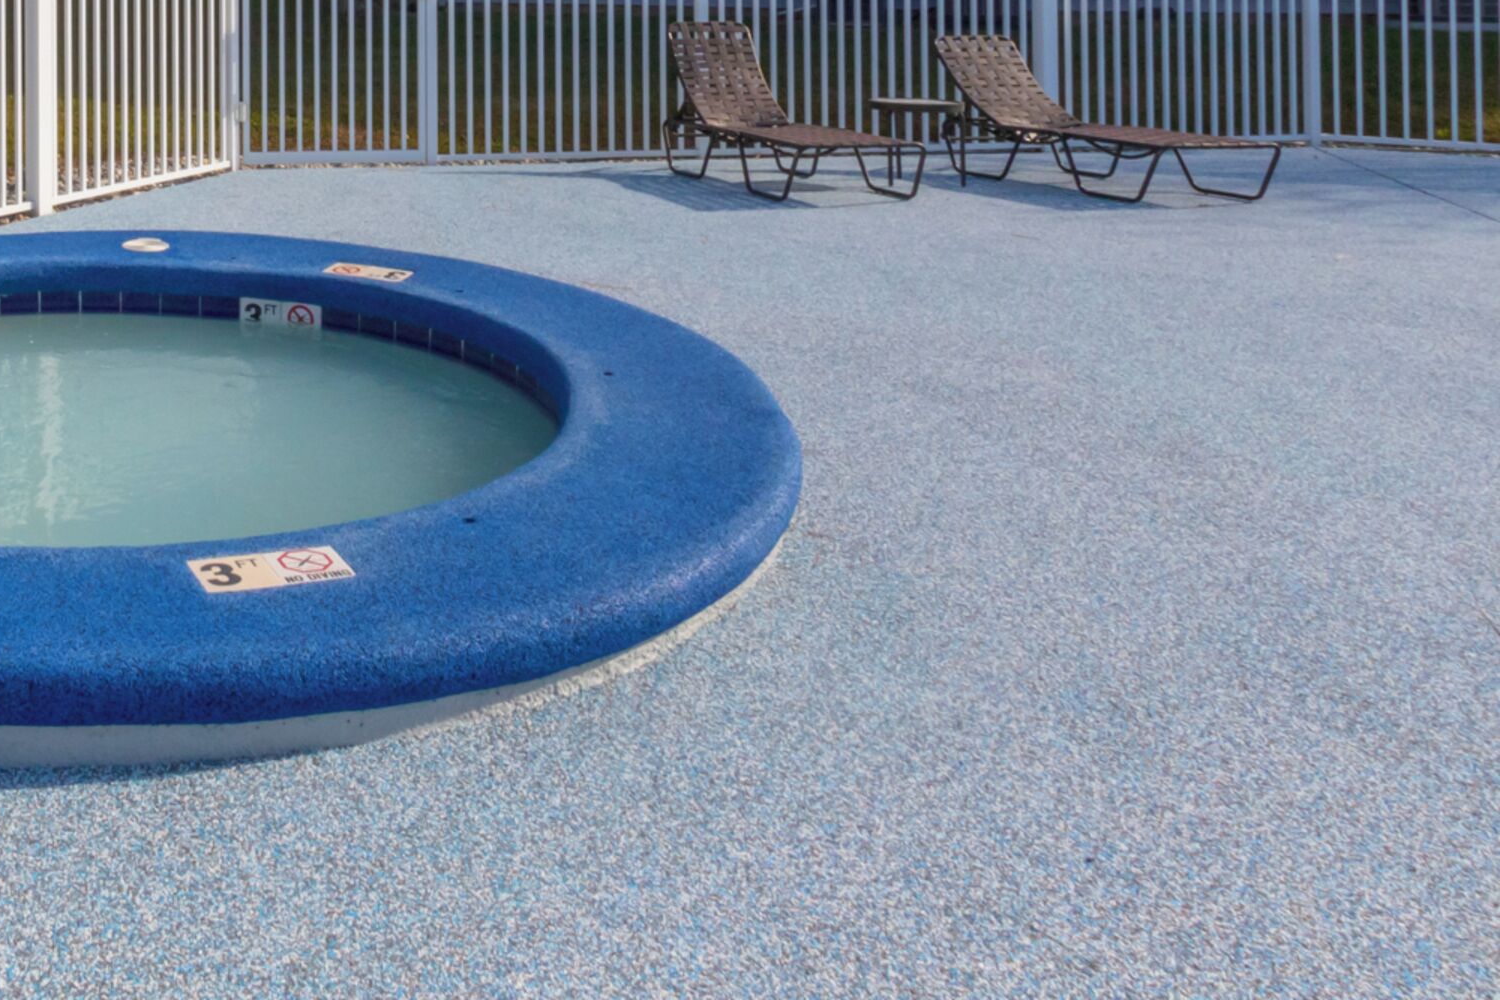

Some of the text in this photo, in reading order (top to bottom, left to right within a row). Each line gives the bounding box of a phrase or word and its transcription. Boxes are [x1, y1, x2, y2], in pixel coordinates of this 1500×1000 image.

[264, 304, 278, 315] FT
[200, 559, 258, 587] 3 FT
[284, 569, 351, 583] NO DIVING
